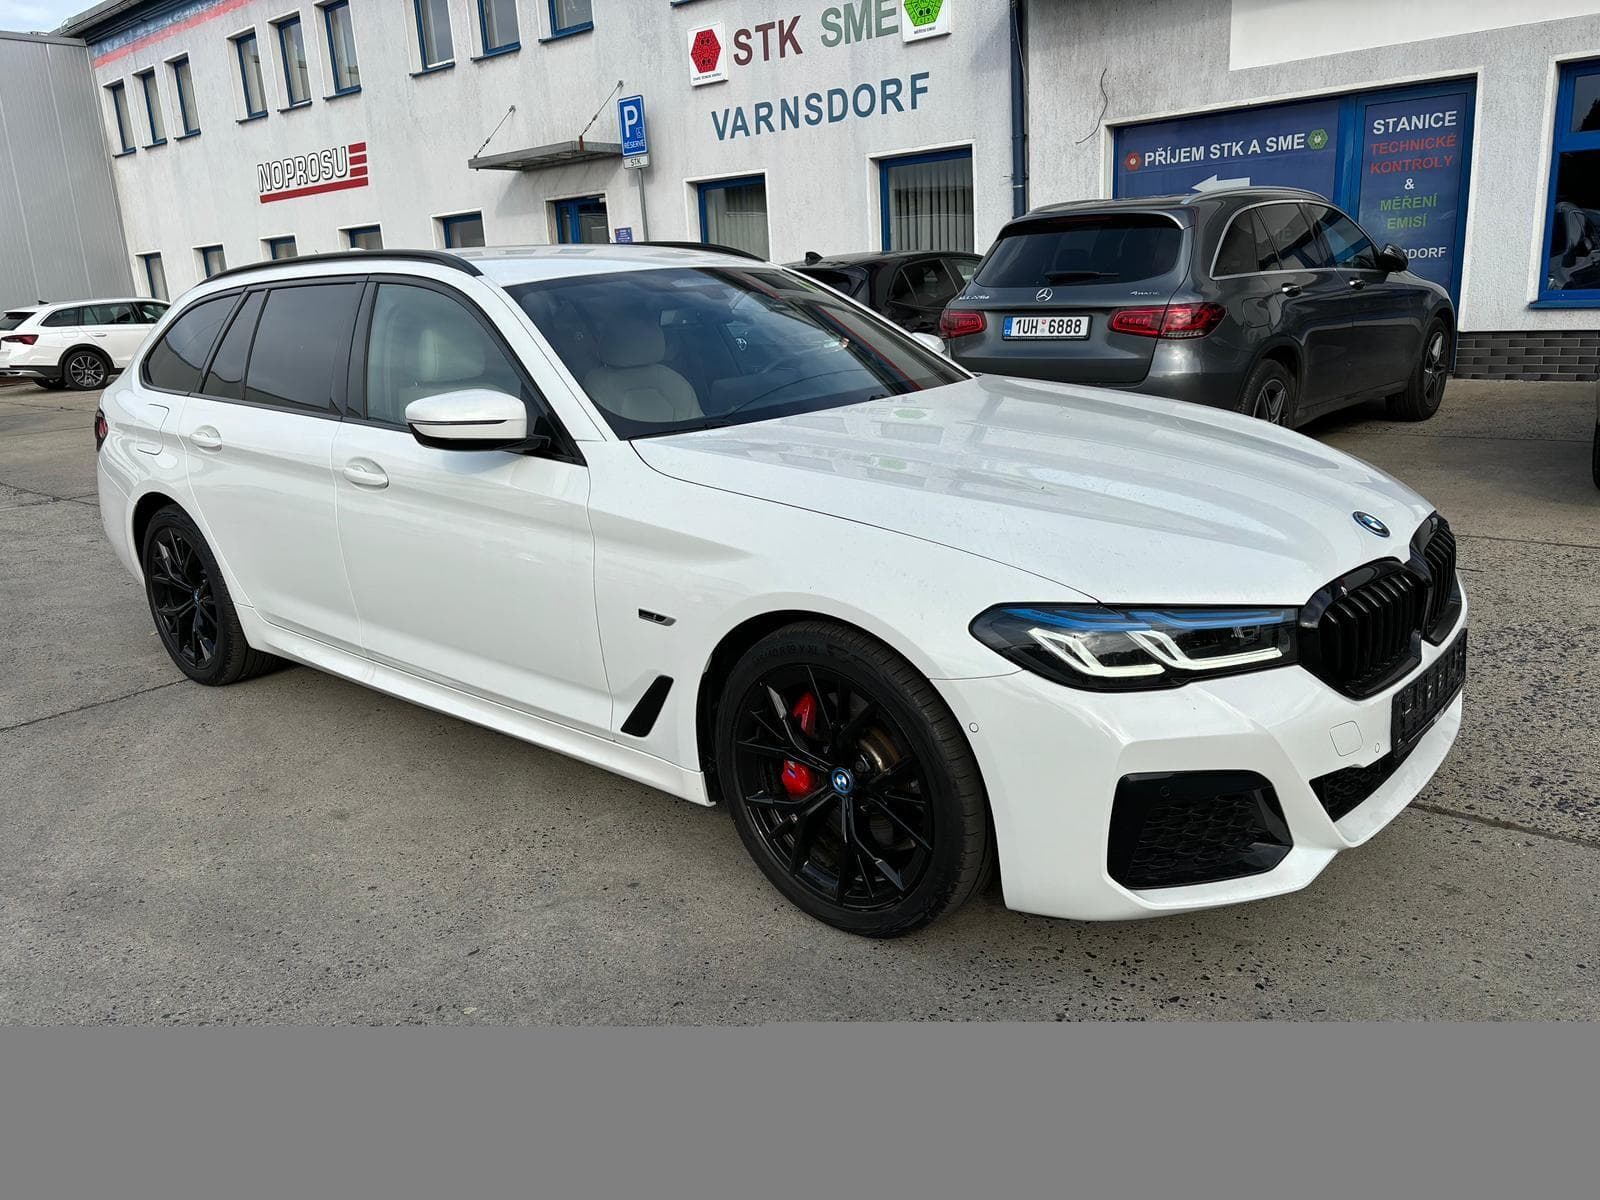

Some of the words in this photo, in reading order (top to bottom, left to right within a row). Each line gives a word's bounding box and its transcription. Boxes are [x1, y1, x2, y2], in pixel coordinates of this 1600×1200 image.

[733, 15, 803, 66] STK
[820, 0, 899, 48] SME
[711, 72, 930, 141] VARNSDORF
[623, 105, 638, 138] P
[1372, 110, 1457, 135] STANICE
[1144, 146, 1205, 167] PŘÍJEM
[1209, 140, 1244, 159] STK
[1247, 139, 1261, 155] A
[1265, 133, 1306, 153] SME
[1371, 133, 1457, 156] TECHNICKÉ
[256, 145, 348, 192] NOPROSU
[630, 157, 642, 167] STK
[1370, 155, 1453, 175] KONTROLY
[1404, 178, 1415, 190] &
[1380, 193, 1438, 211] MĚŘENÍ
[1386, 213, 1427, 230] EMISÍ
[1015, 318, 1039, 335] 1UH
[1048, 318, 1081, 335] 6888
